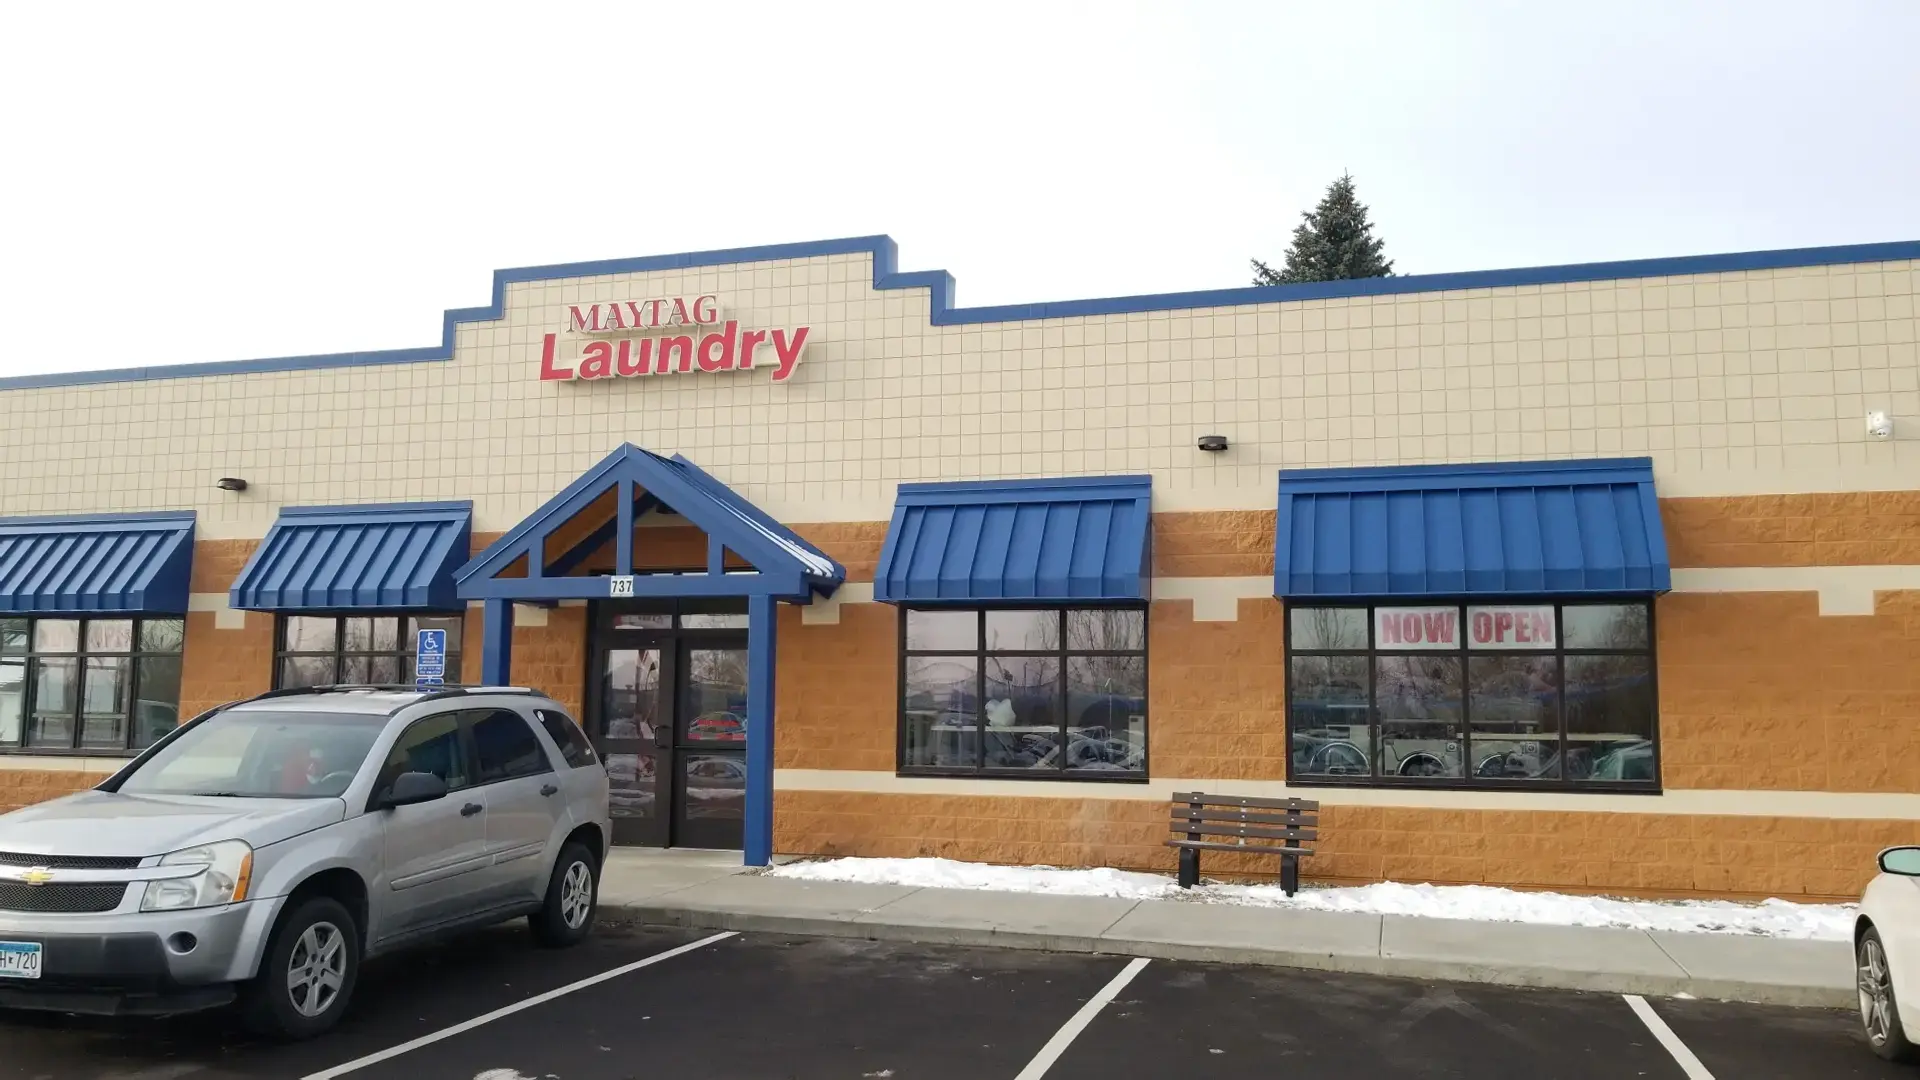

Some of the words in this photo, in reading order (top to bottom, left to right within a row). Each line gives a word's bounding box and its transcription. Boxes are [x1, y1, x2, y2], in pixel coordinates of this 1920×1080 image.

[566, 295, 718, 333] MAYTAG
[539, 320, 810, 381] Laundry
[611, 580, 632, 593] 737
[1381, 612, 1457, 644] NOW
[1473, 611, 1552, 644] OPEN
